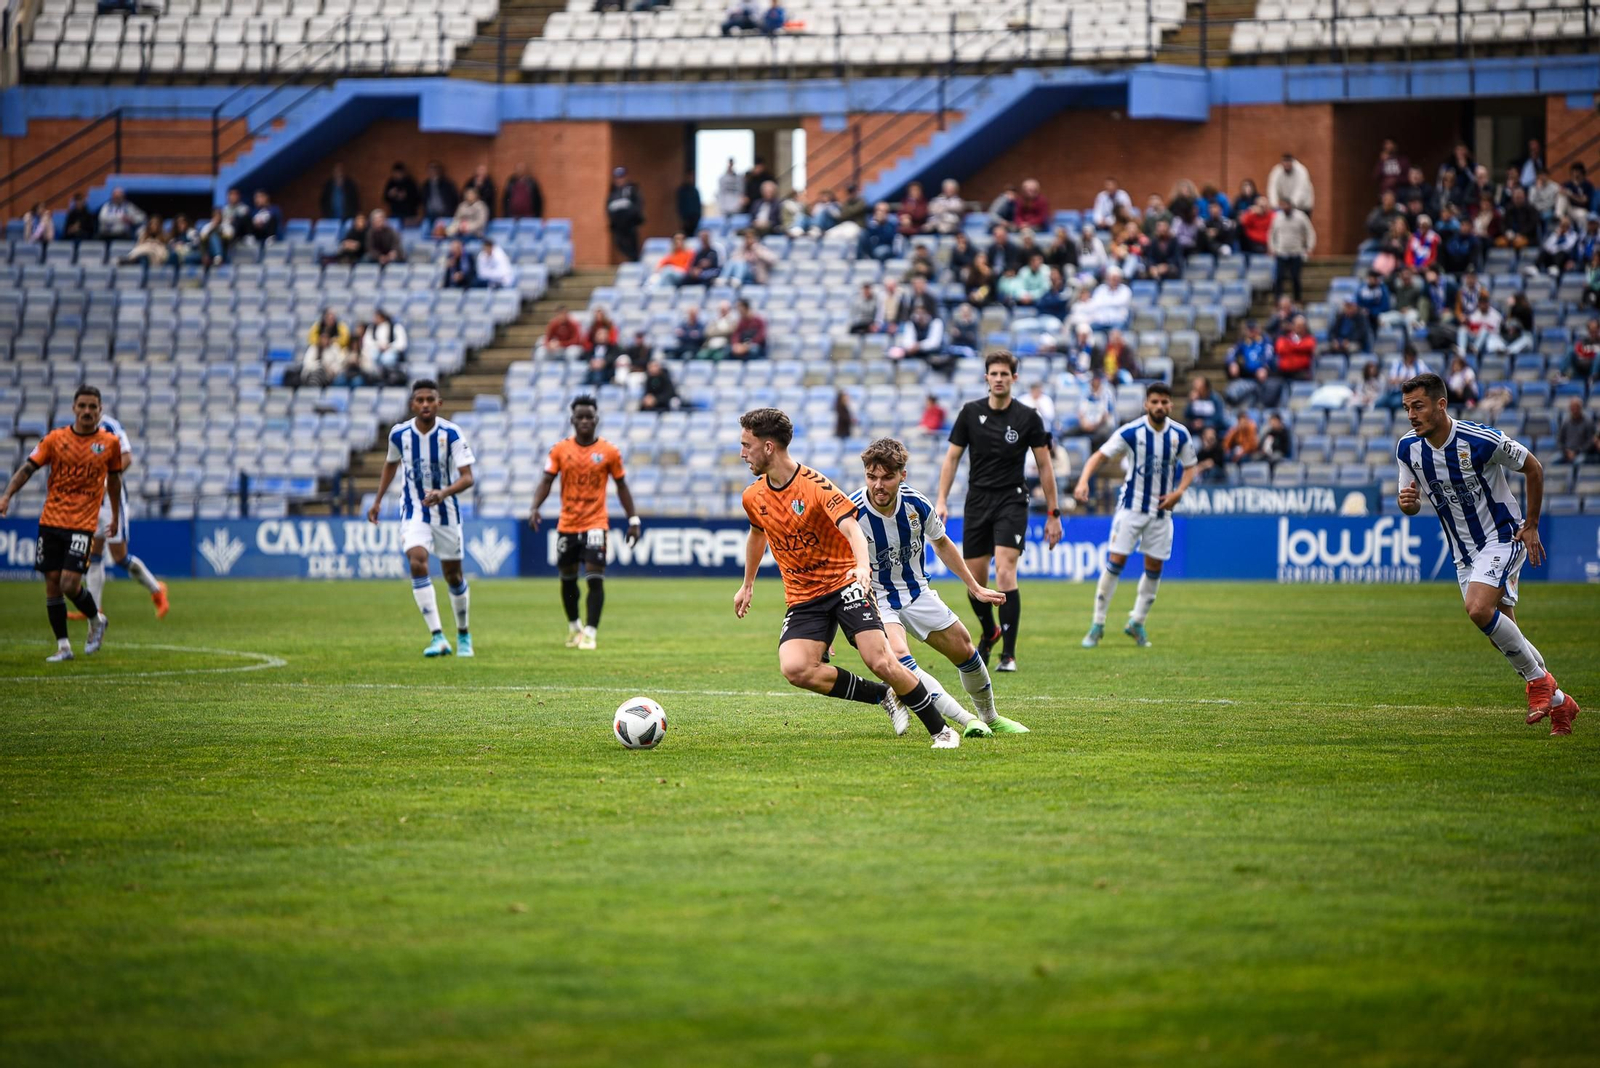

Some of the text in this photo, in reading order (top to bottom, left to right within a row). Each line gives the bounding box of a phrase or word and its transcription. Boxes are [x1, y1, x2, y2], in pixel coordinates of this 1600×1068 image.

[1213, 487, 1337, 514] INTERNAUTA
[256, 520, 336, 557] CAJA
[1278, 516, 1422, 566] lowfit
[309, 554, 353, 578] DEL
